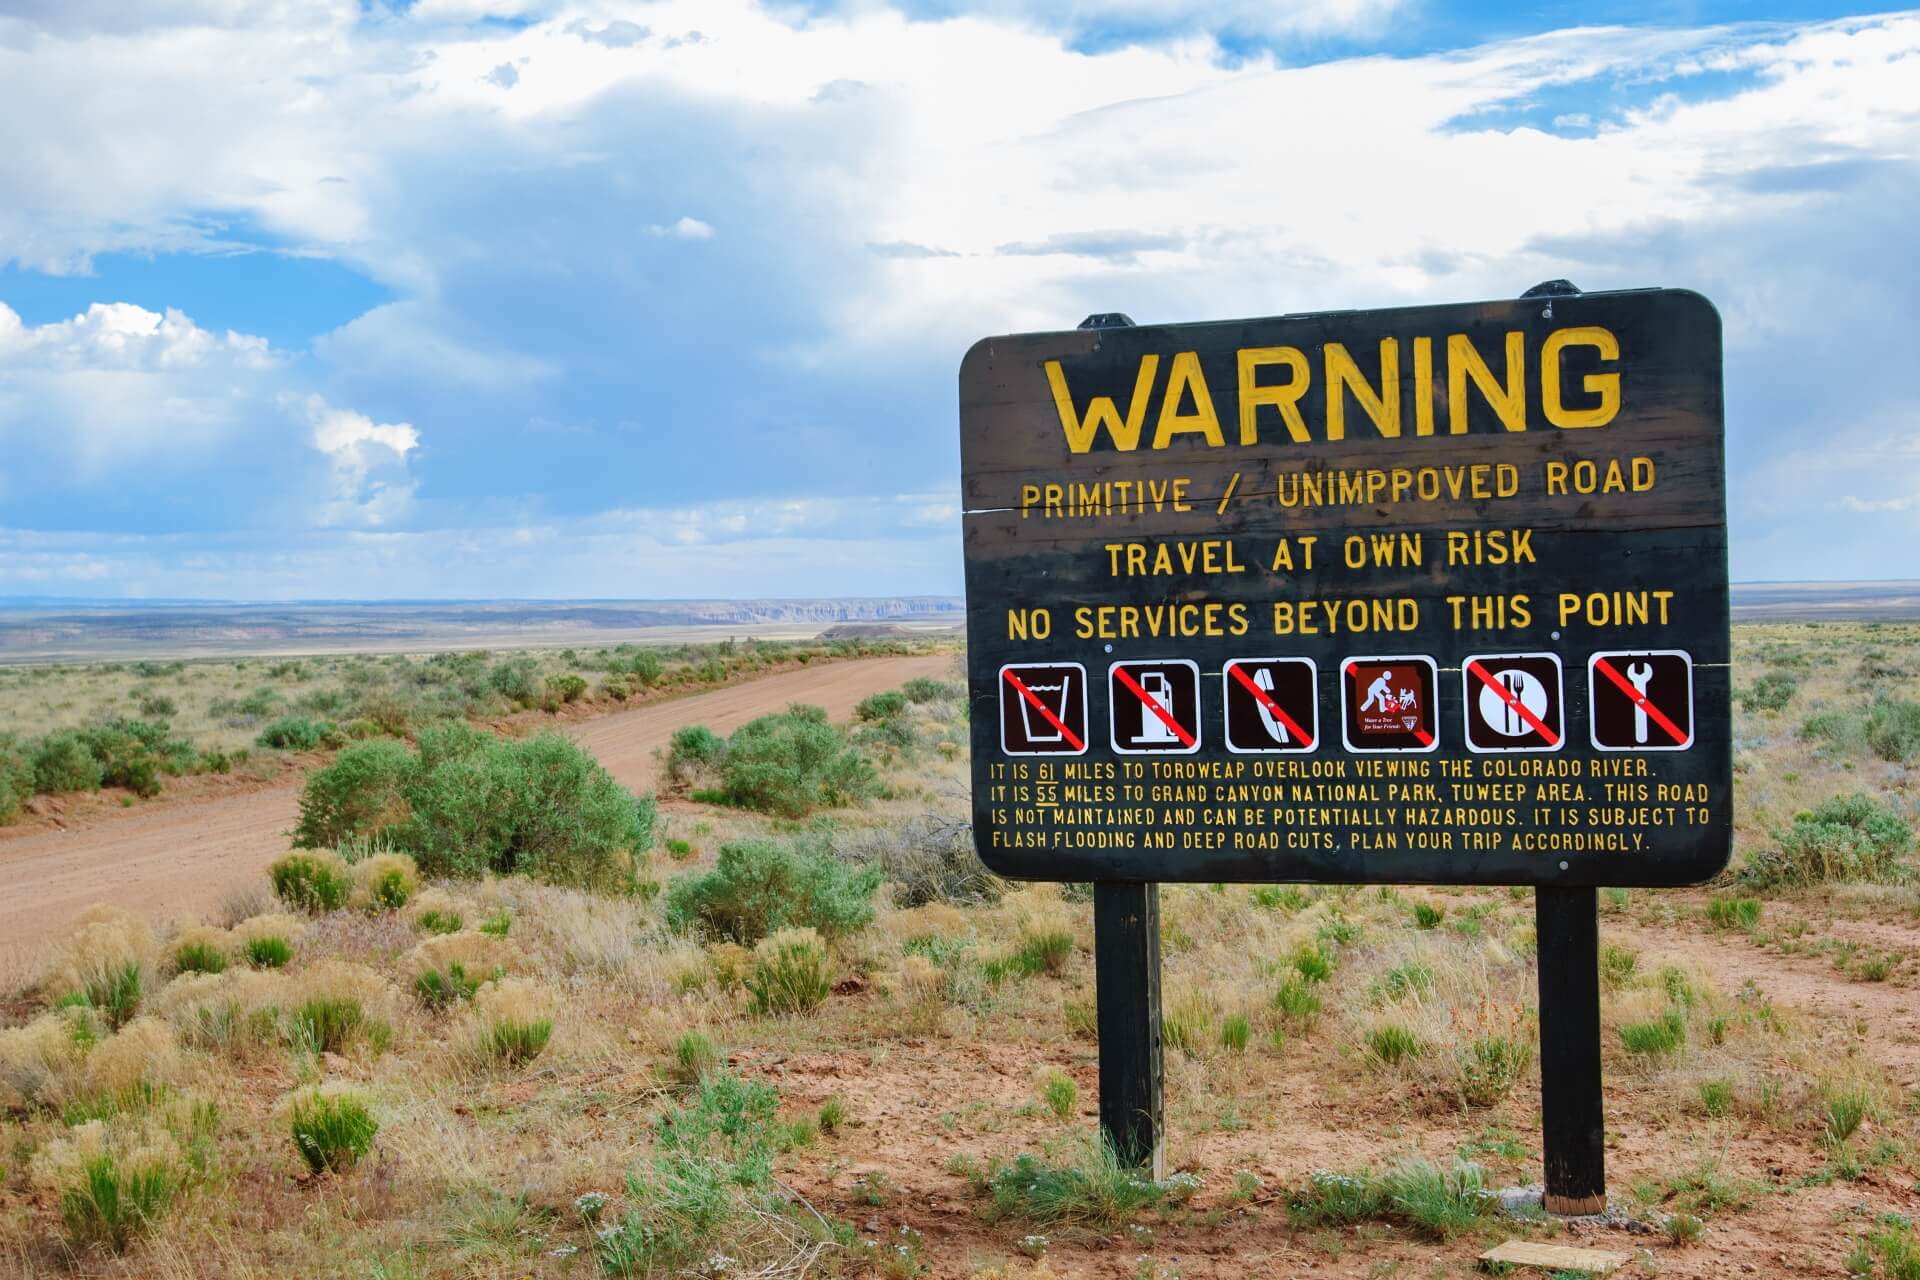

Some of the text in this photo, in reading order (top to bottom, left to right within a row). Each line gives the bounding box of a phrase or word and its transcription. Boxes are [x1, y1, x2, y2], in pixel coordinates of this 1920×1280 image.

[1045, 327, 1620, 453] WARNING
[1023, 479, 1191, 518] PRIMITIVE
[1218, 474, 1239, 513] /
[1547, 458, 1654, 495] ROAD
[1105, 529, 1535, 576] TRAVEL AT OWN RISK
[1009, 591, 1673, 640] NO SERVICES BEYOND THIS POINT
[990, 758, 1656, 781] IT IS 61 MILES TO TOROWEAP OVERLOOK VIEWING THE COLORADO RIVER.
[991, 782, 1709, 804] IT IS 55 MILES TO GRAND CANYON NATIONAL PARK, TUWEEP AREA. THIS ROAD
[991, 806, 1710, 827] IS NOT MAINTAINED AND CAN BE POTENTIALLY HAZARDOUS. IT IS SUBJECT TO
[992, 831, 1047, 849] FLASH
[1053, 831, 1135, 849] FLOODING
[1143, 831, 1175, 849] AND
[1183, 831, 1226, 850] DEEP
[1234, 831, 1279, 850] ROAD
[1350, 831, 1398, 849] PLAN
[1405, 831, 1453, 849] YOUR
[1461, 831, 1503, 849] TRIP
[1511, 832, 1650, 850] ACCORDINGLY.
